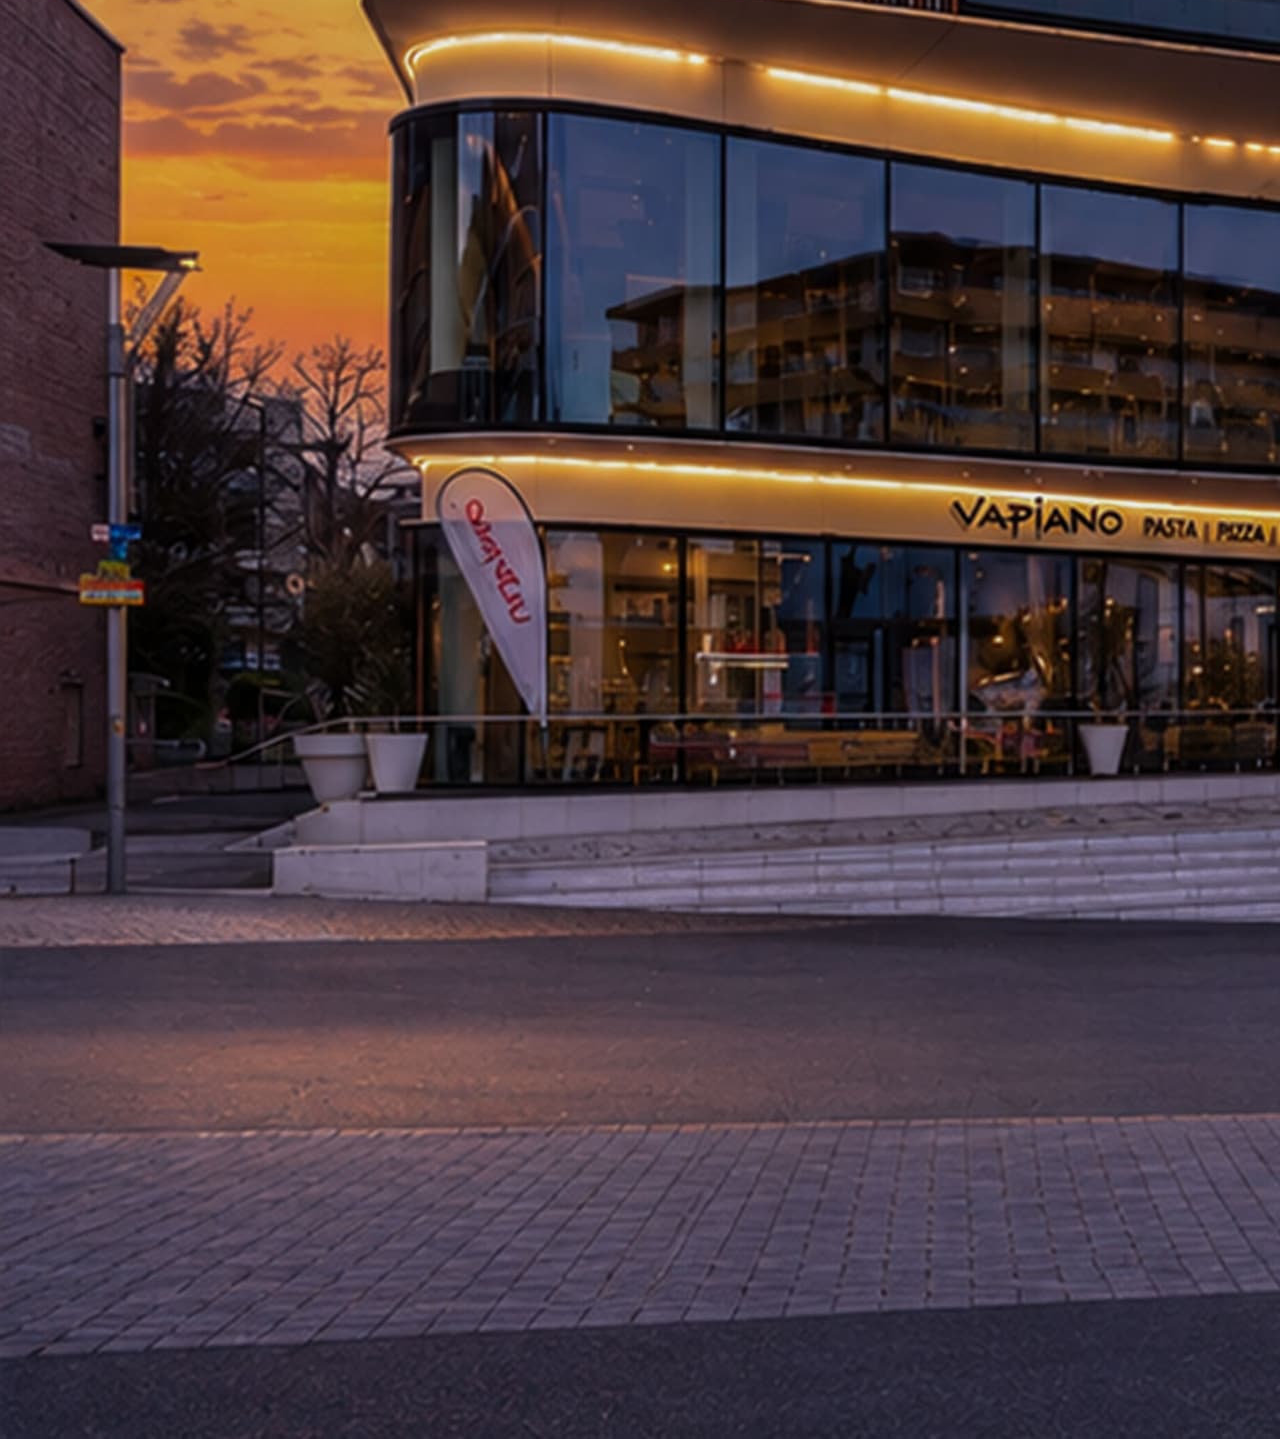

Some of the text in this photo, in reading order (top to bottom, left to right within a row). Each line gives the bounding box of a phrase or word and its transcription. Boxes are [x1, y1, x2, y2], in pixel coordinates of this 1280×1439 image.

[949, 496, 1125, 540] VAPIANO
[1142, 515, 1198, 540] PASTA
[1215, 521, 1266, 545] PIZZA
